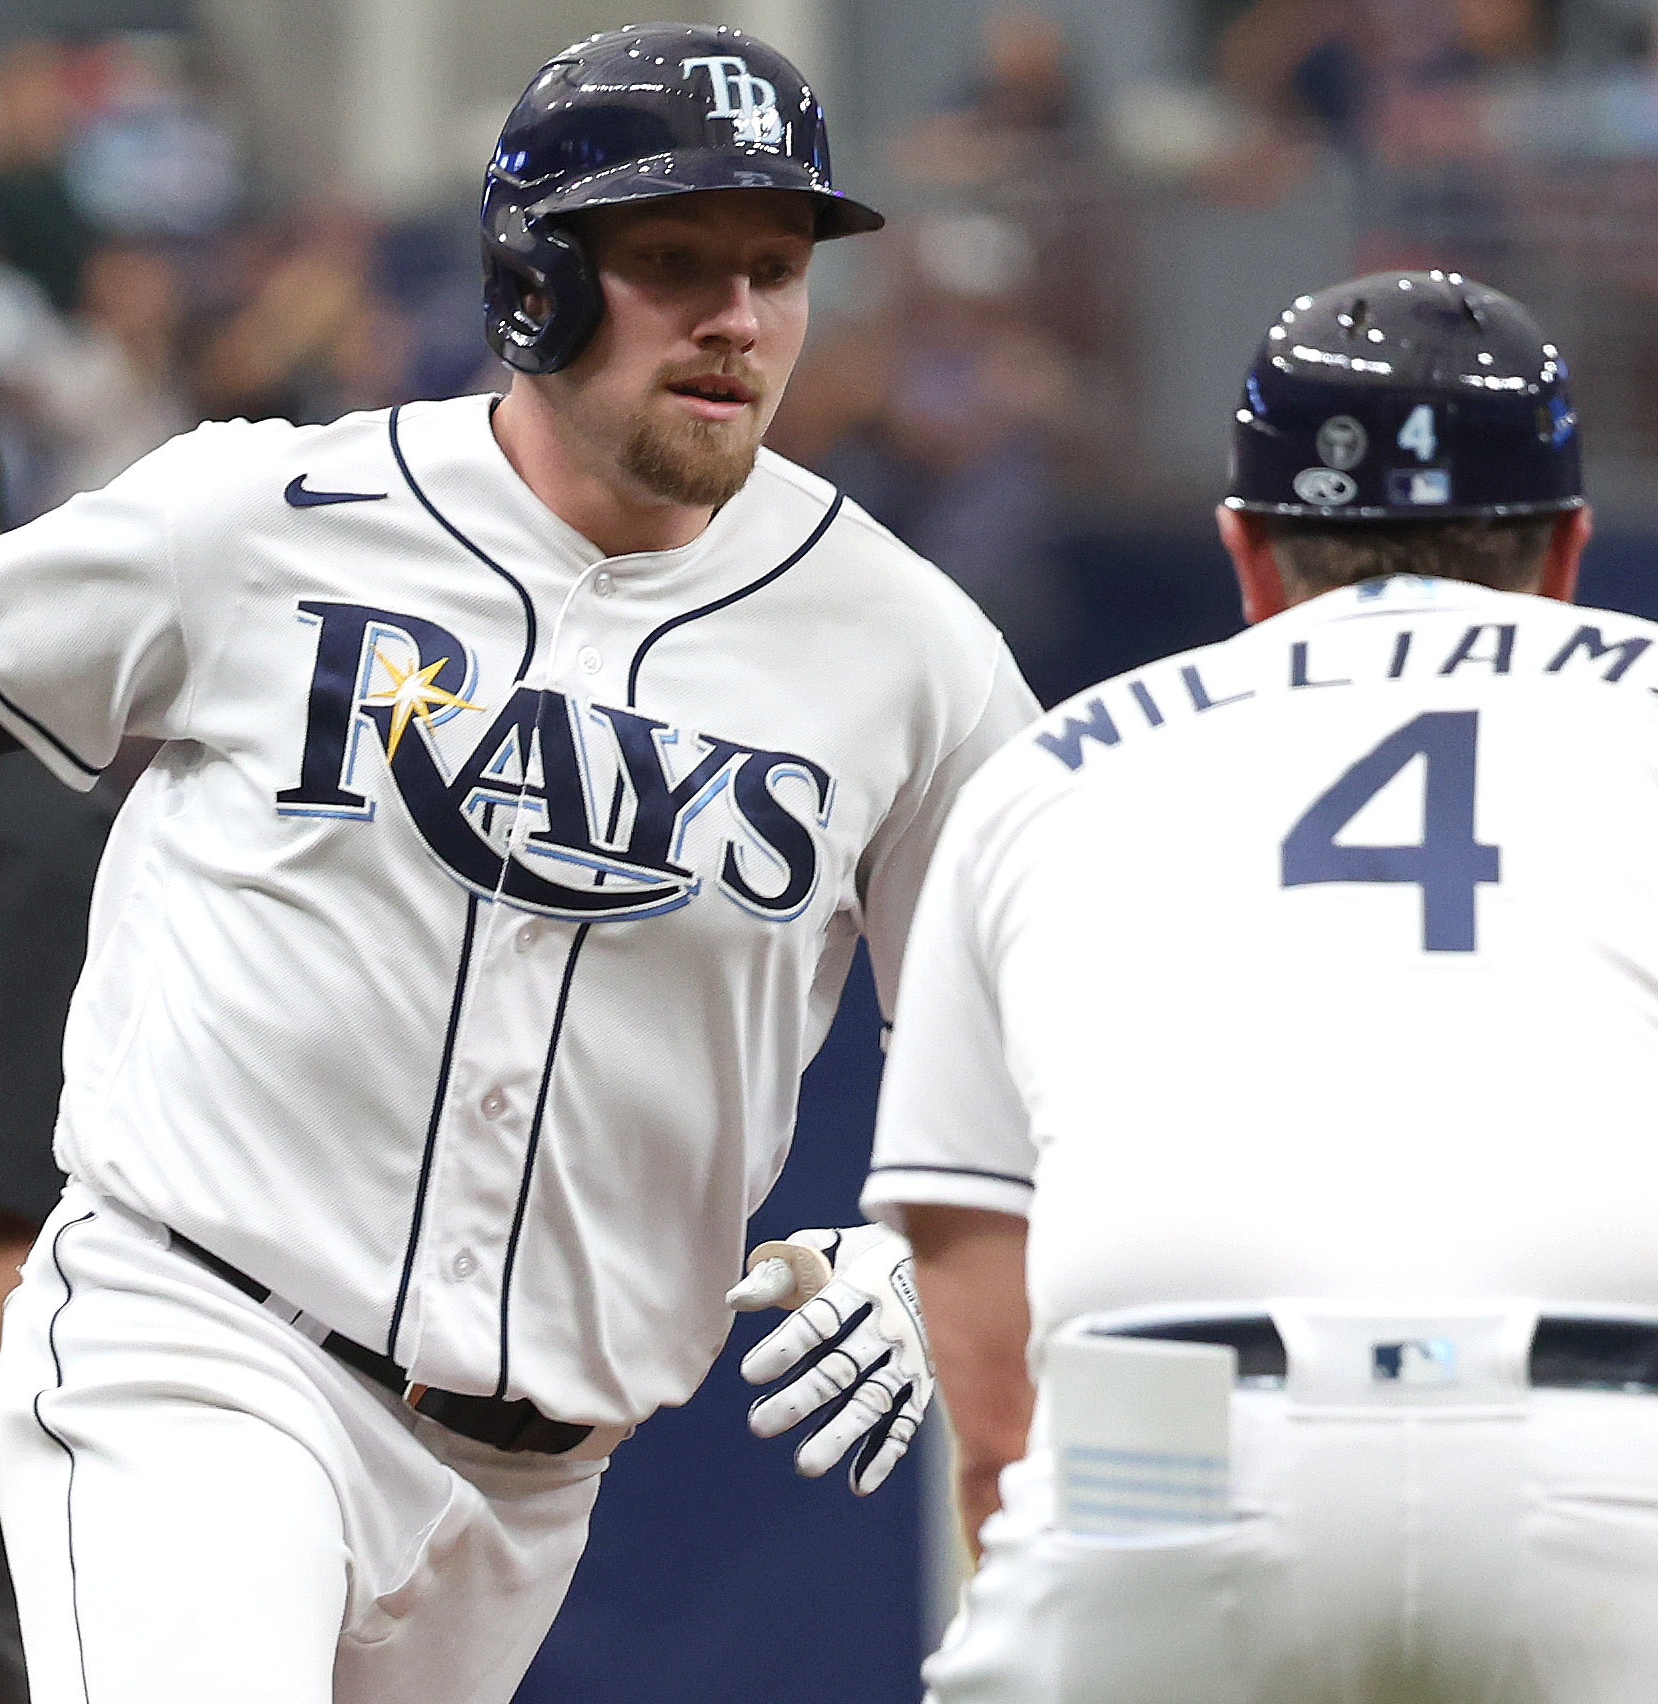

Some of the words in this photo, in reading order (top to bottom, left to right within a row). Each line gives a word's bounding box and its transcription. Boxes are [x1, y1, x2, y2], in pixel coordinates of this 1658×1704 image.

[1396, 404, 1438, 461] 4
[275, 600, 837, 922] RAYS
[1280, 709, 1501, 953] 4
